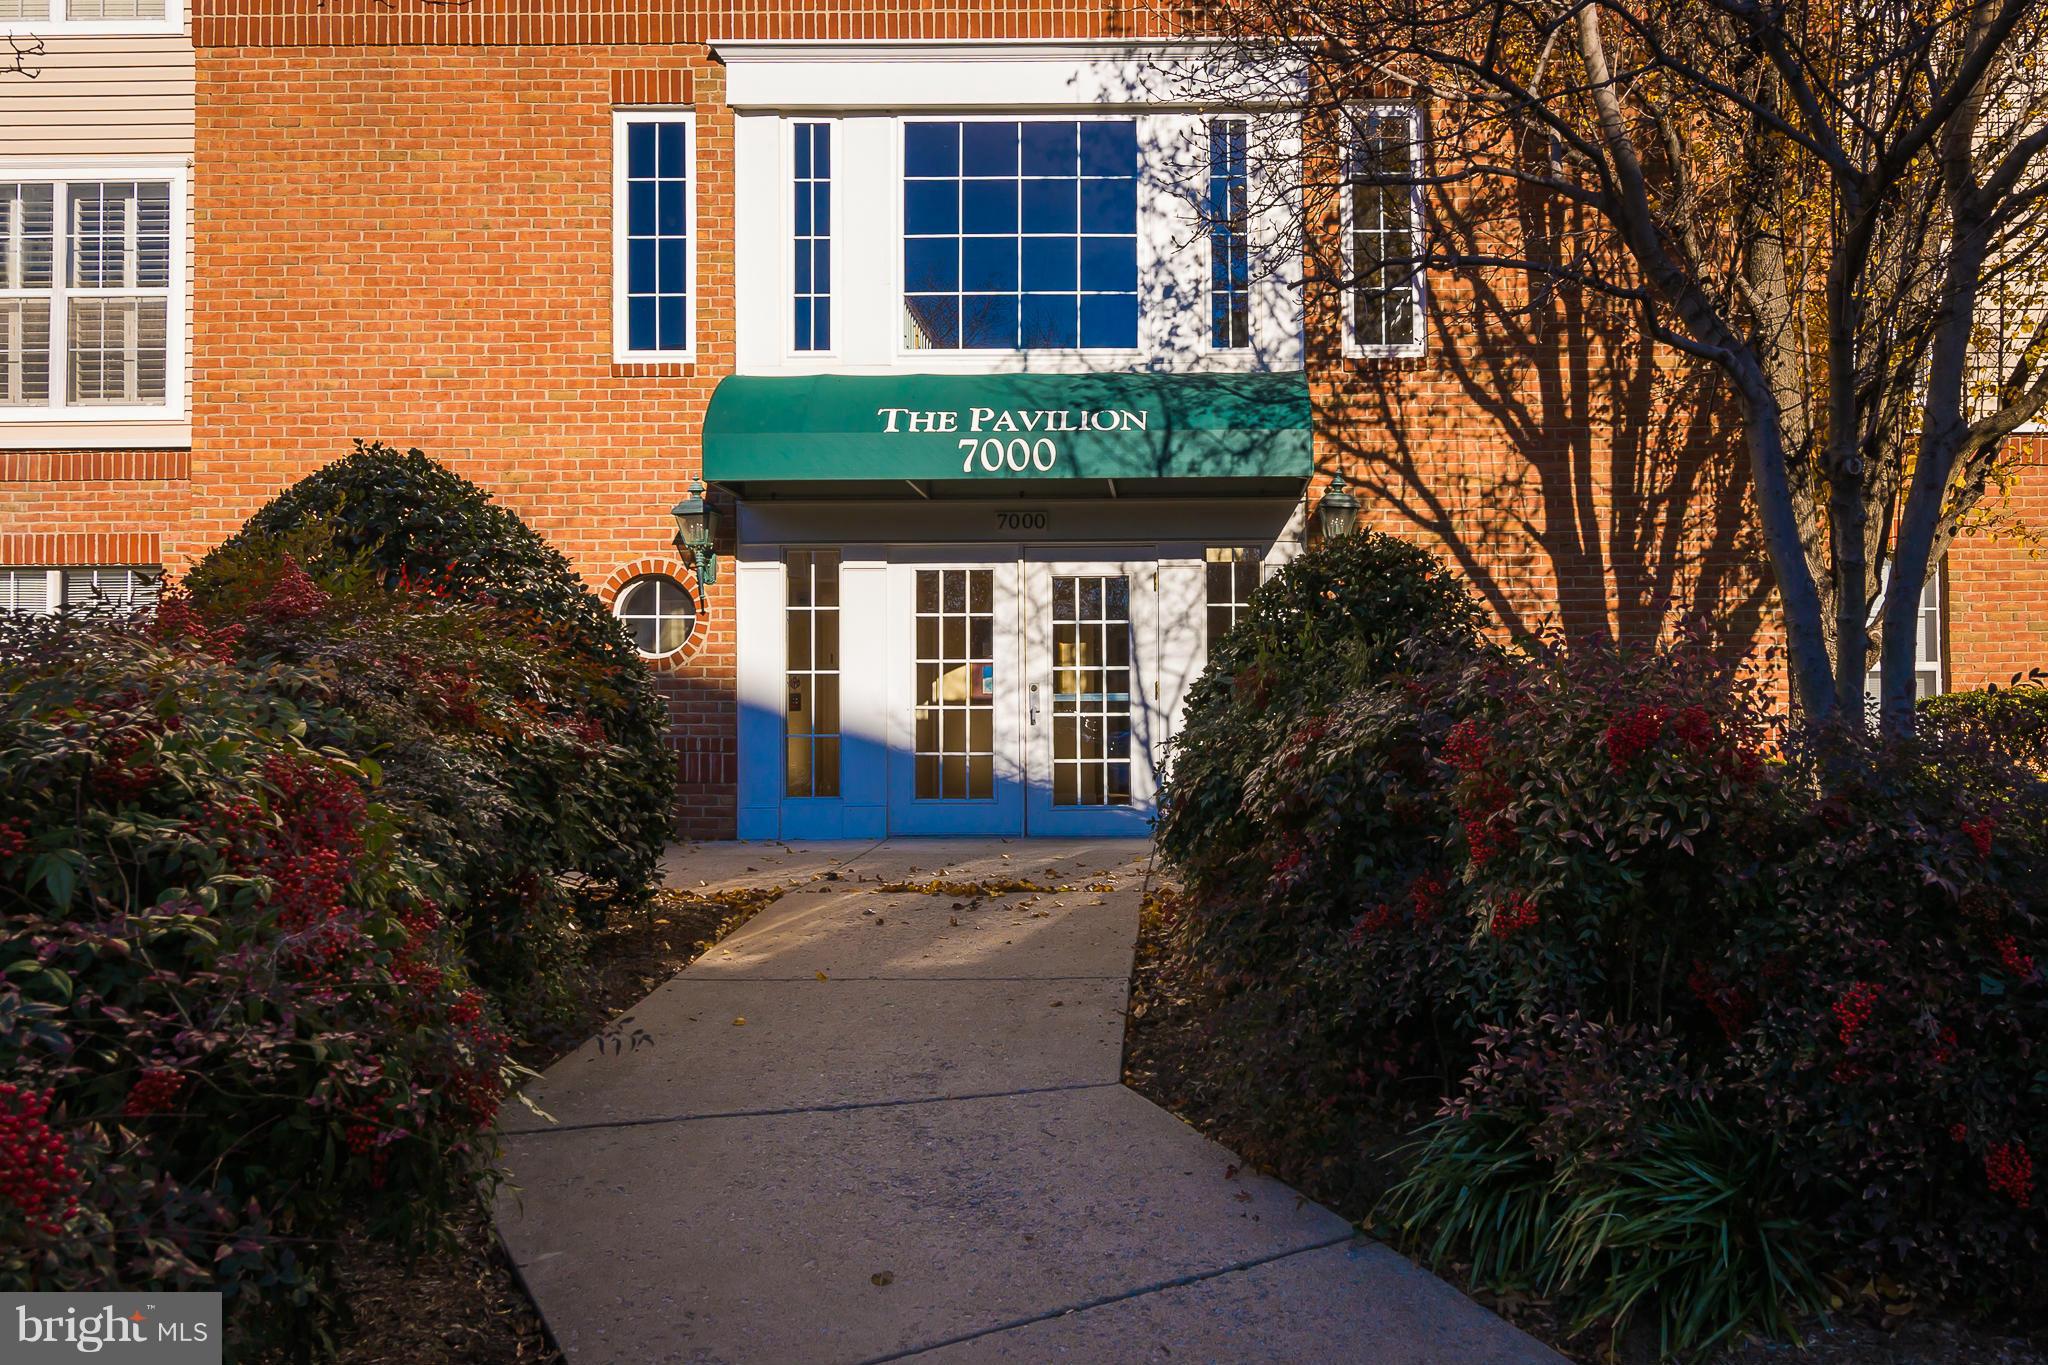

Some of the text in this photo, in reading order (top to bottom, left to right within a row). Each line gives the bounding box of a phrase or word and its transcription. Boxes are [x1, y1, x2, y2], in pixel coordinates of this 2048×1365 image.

[877, 407, 1148, 433] THE PAVILION
[958, 438, 1057, 473] 7000
[996, 513, 1047, 530] 7000
